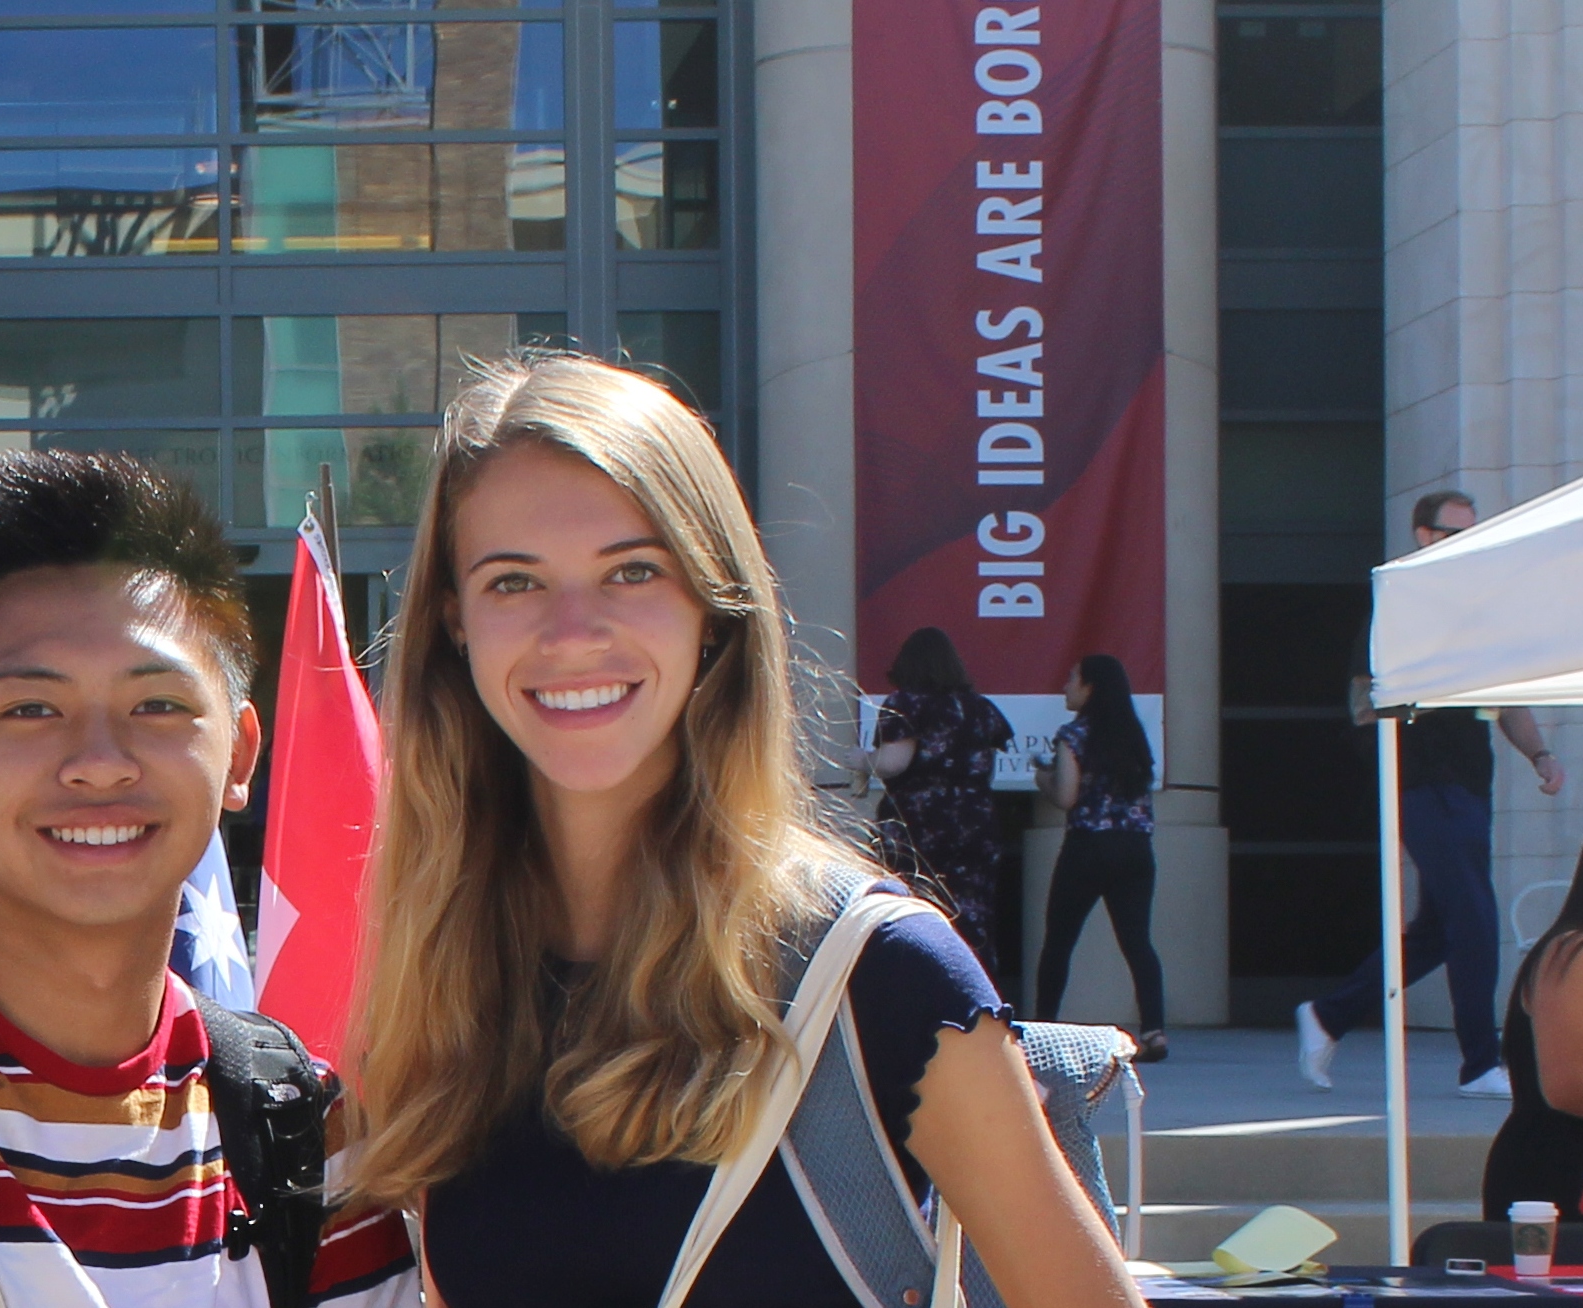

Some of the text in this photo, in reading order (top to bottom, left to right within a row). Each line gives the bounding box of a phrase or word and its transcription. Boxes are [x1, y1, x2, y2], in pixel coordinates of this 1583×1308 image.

[975, 7, 1045, 617] BIG IDEAS ARE BOR
